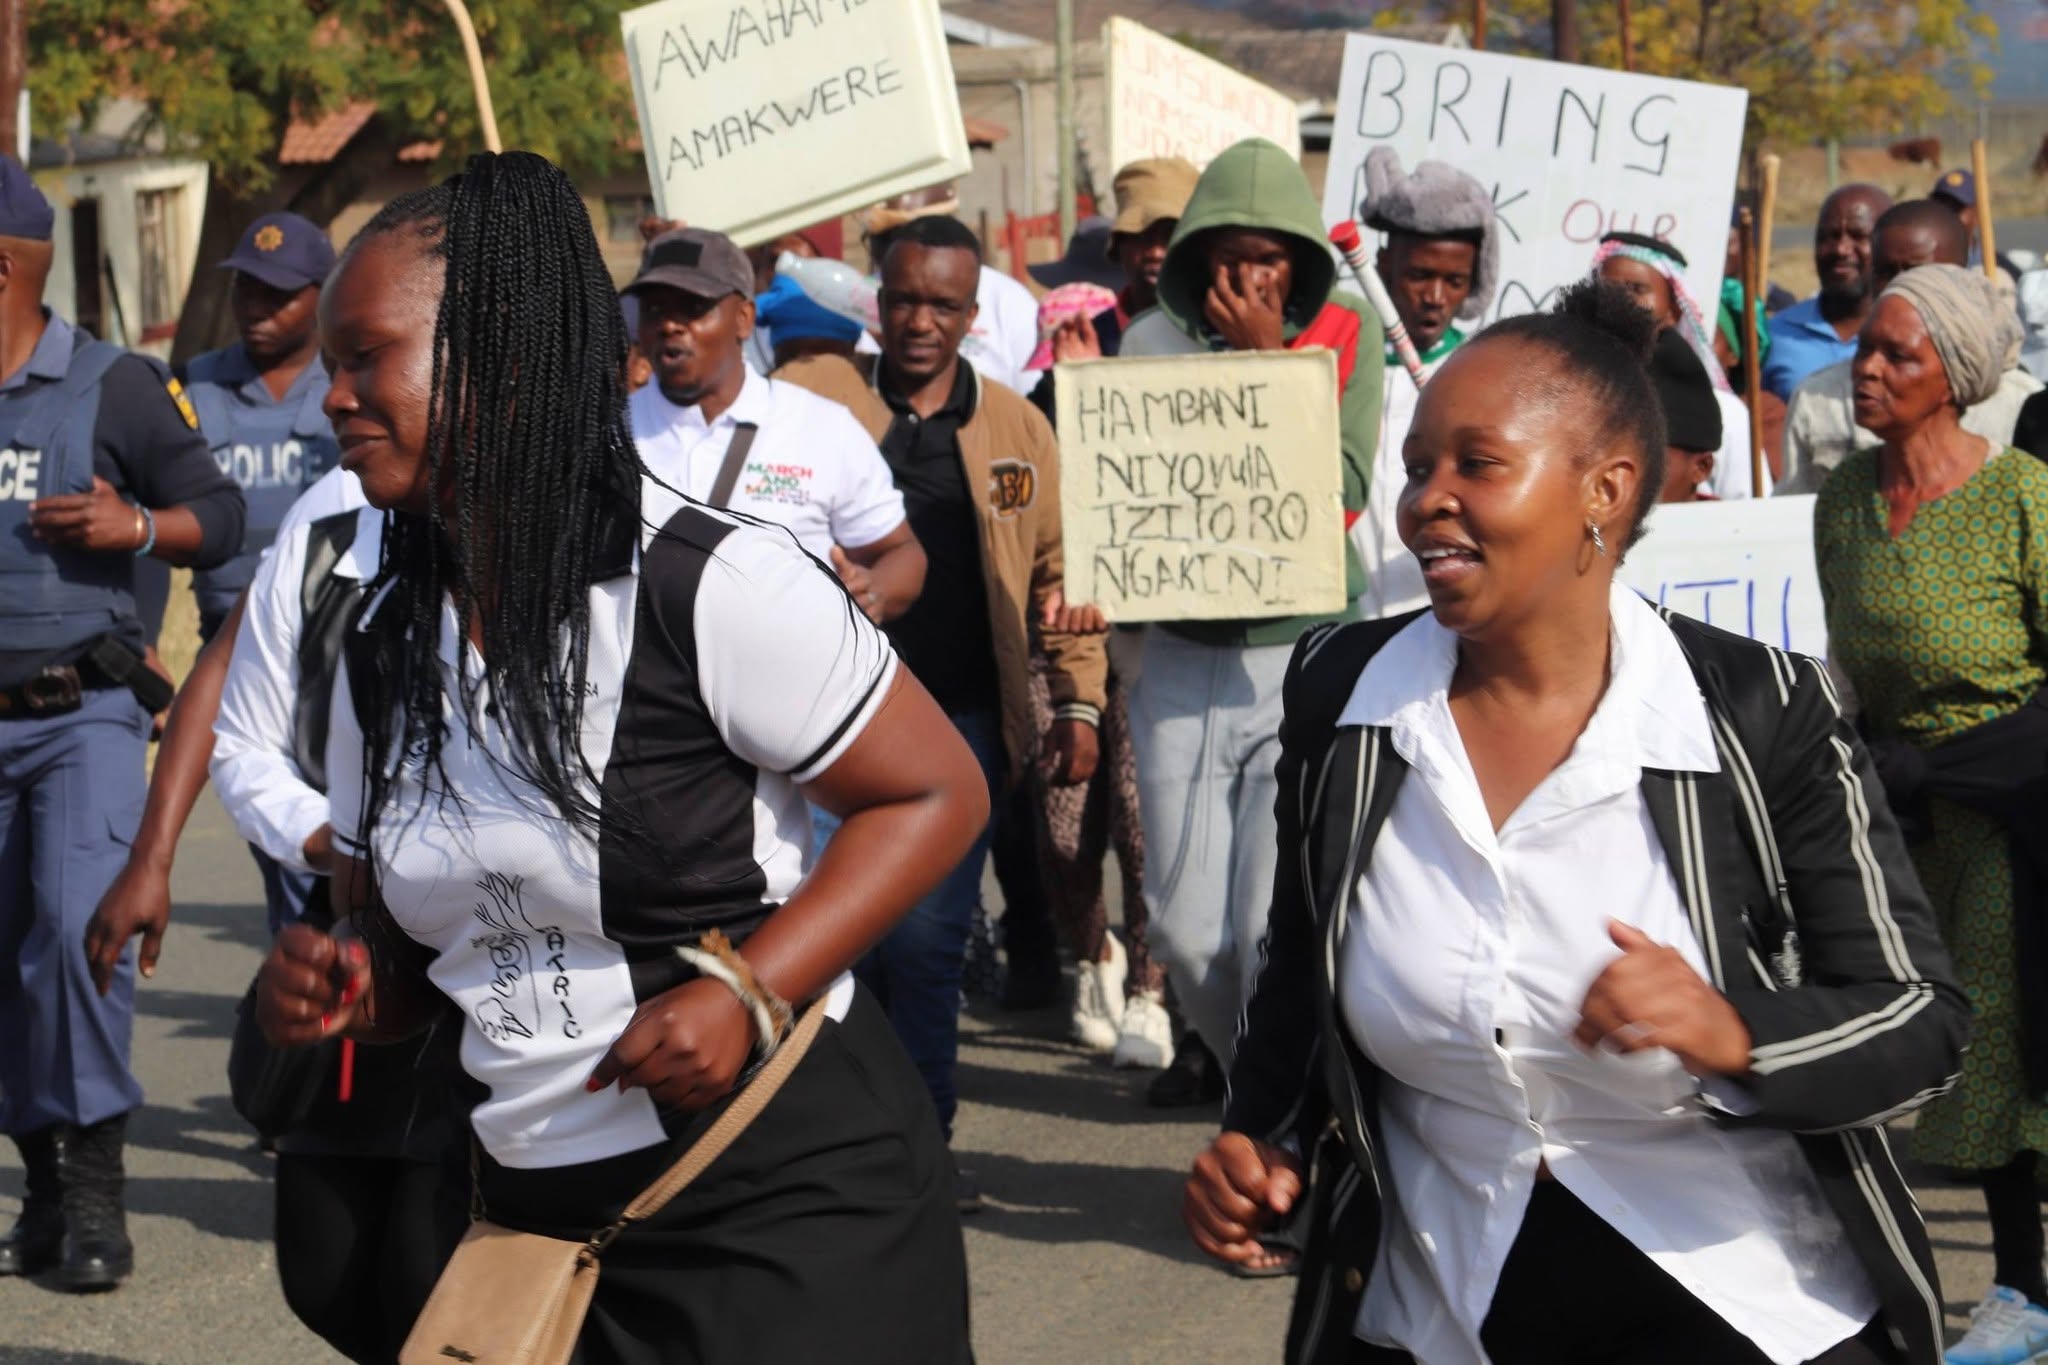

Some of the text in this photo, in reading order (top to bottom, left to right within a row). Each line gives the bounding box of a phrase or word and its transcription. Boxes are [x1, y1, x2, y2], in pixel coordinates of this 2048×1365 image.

[666, 58, 903, 181] AMAKWERE
[1357, 49, 1678, 177] BRING
[1079, 384, 1269, 443] HAMBANI
[746, 463, 813, 479] MARCH
[762, 474, 799, 489] AND
